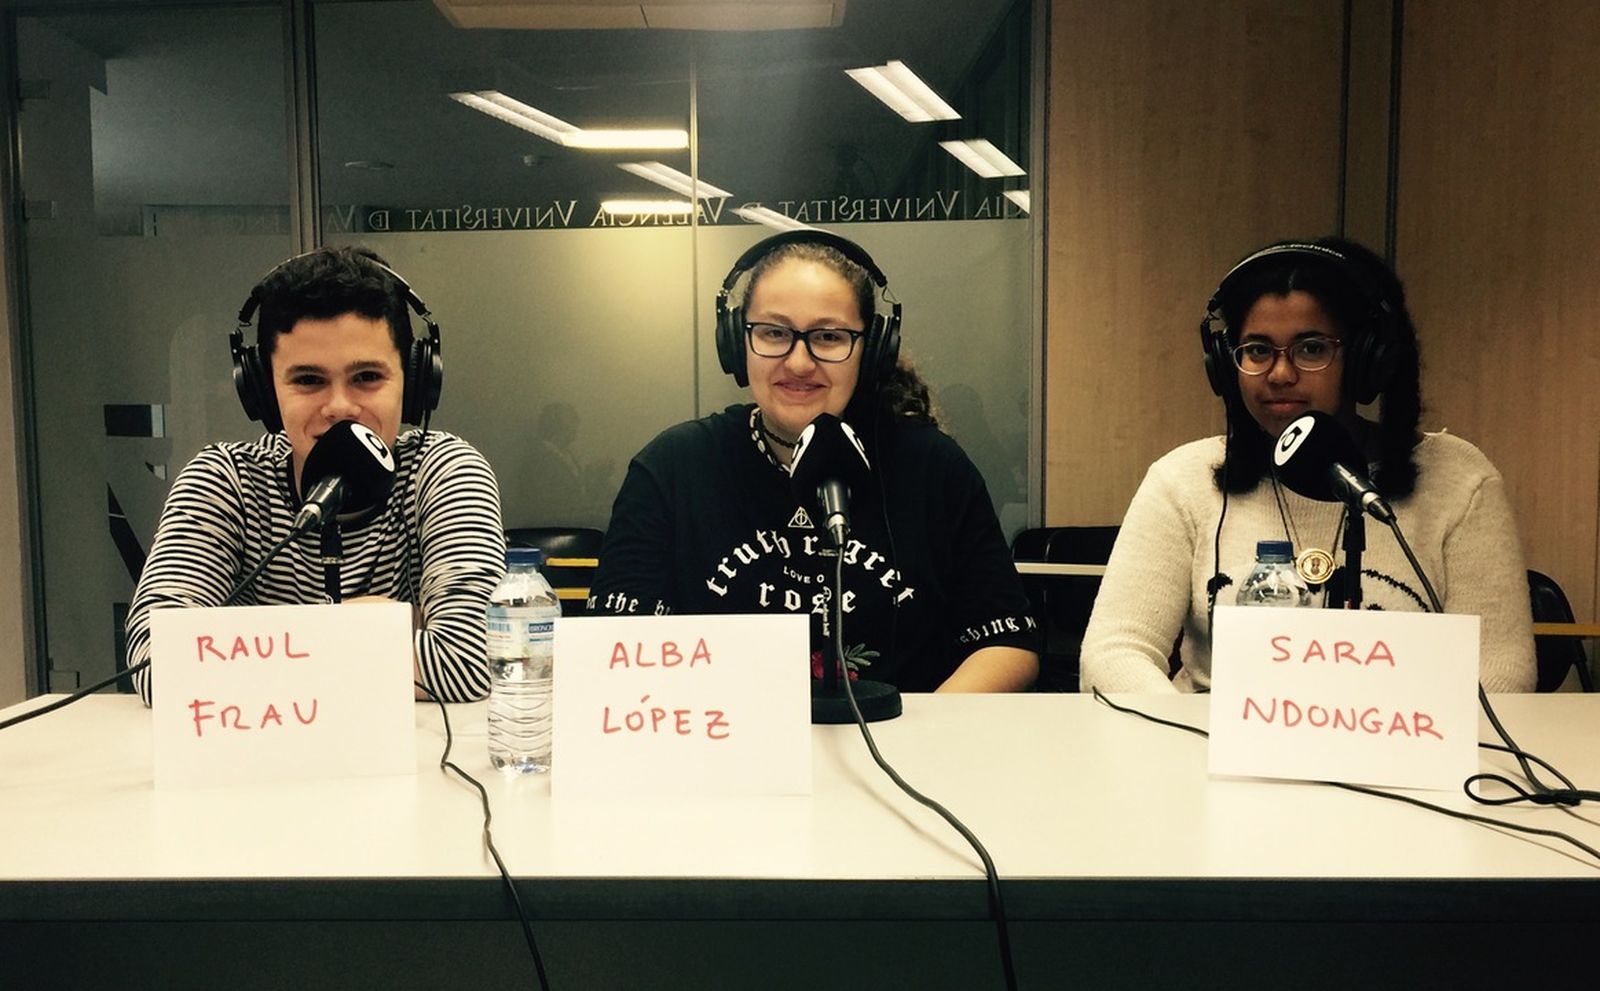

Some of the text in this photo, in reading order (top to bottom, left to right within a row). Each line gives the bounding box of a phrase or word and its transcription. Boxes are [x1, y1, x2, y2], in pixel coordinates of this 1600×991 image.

[706, 529, 915, 608] truth rgret
[783, 565, 811, 584] LOVE
[604, 592, 639, 614] the
[197, 632, 310, 662] RAUL
[609, 638, 713, 669] ALBA
[1270, 636, 1396, 667] SARA
[188, 699, 318, 737] FRAU
[602, 694, 730, 740] LÓPEZ
[1242, 696, 1444, 740] NDONGAR
